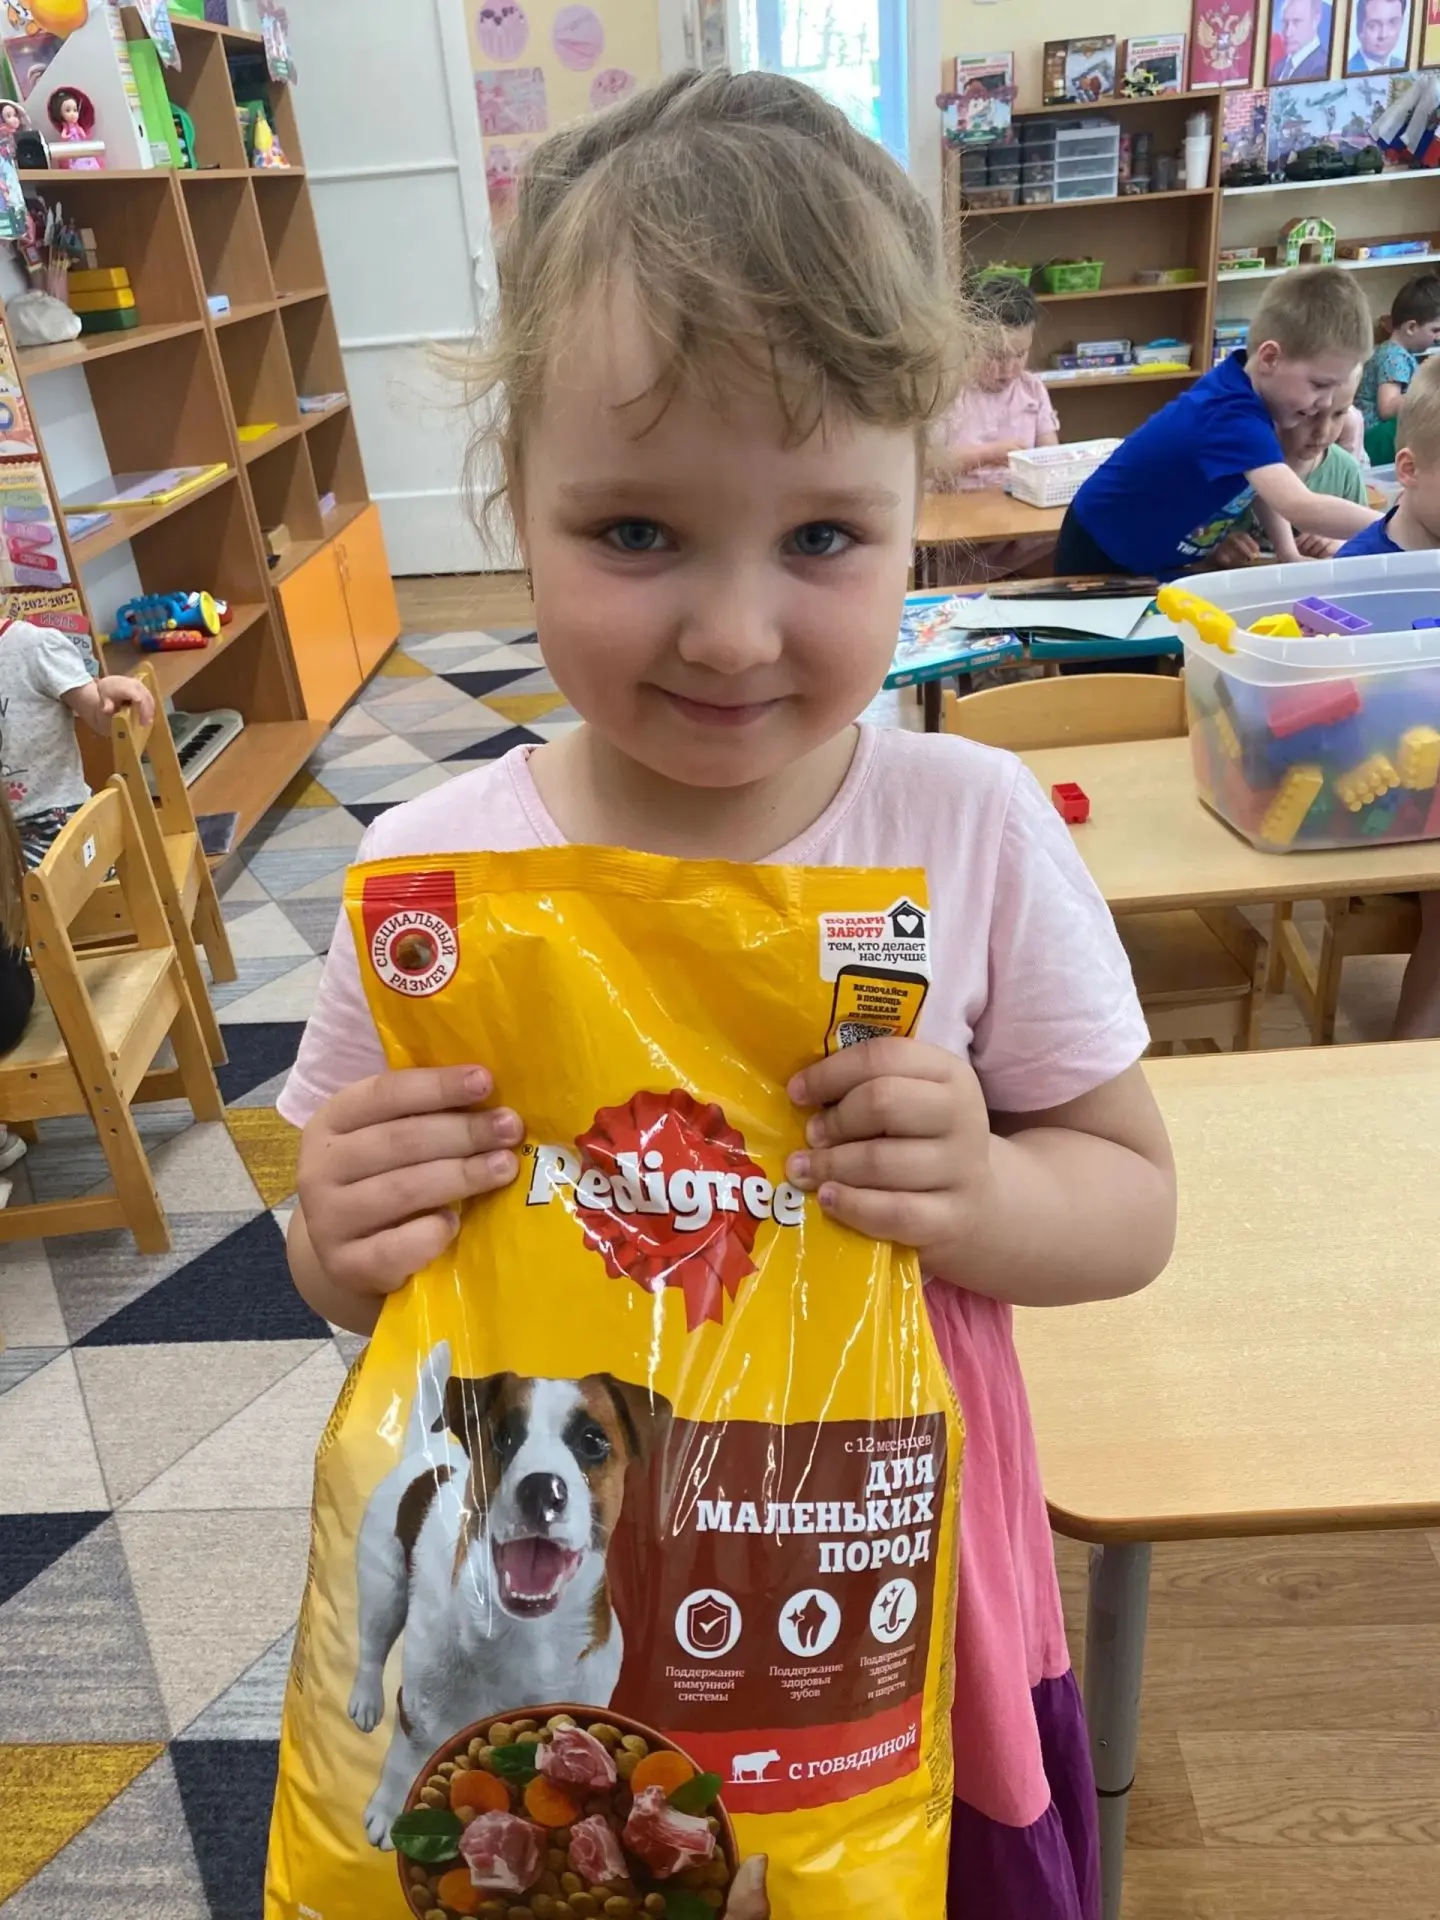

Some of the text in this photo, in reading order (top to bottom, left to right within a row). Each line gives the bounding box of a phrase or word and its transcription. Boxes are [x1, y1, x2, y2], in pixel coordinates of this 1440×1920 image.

[48, 592, 76, 608] 2027
[40, 612, 77, 628] ИЮЛЬ
[824, 916, 886, 925] ПОДАРИ
[827, 927, 884, 938] ЗАБОТУ
[374, 912, 457, 968] СПЕЦИАЛЬНЫЙ
[858, 942, 880, 951] кто
[881, 942, 926, 952] делает
[859, 953, 927, 964] нас лучше
[389, 964, 448, 991] РАЗМЕР
[853, 984, 908, 997] ВКЛЮЧАЙСЯ
[857, 1003, 898, 1013] СОБАКАМ
[527, 1144, 805, 1232] Pedigree
[857, 1437, 875, 1453] 12
[876, 1434, 932, 1452] месяцев
[866, 1453, 935, 1498] ДЛЯ
[696, 1491, 934, 1534] МАЛЕНЬКИХ
[818, 1529, 931, 1573] ПОРОД
[665, 1666, 745, 1679] Поддержание
[769, 1663, 844, 1677] Поддержание
[674, 1679, 735, 1691] иммунной
[781, 1676, 831, 1689] здоровья
[678, 1692, 729, 1702] системы
[790, 1688, 821, 1701] зубов
